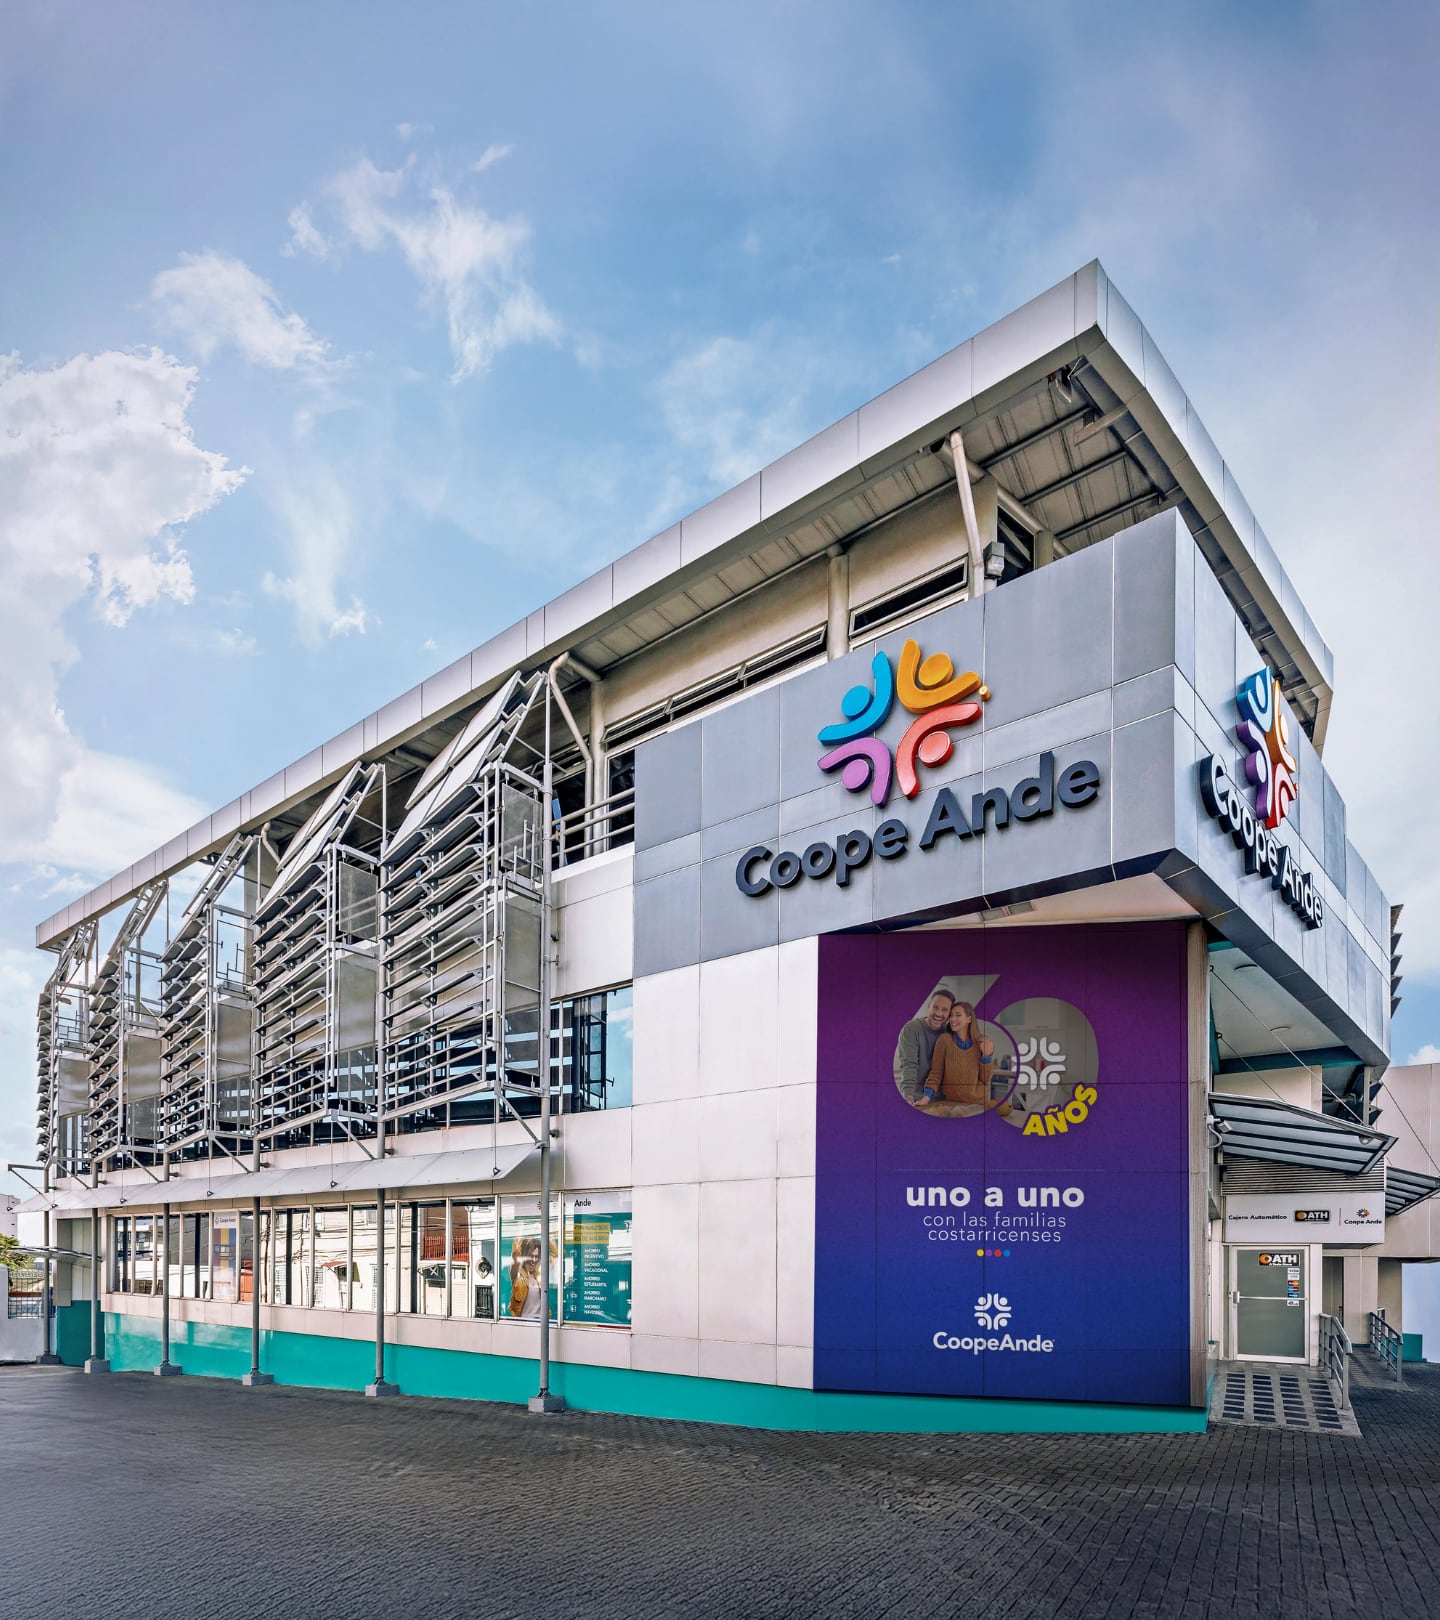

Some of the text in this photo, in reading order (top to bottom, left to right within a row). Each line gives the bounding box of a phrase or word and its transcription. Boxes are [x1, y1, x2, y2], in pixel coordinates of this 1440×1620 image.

[736, 751, 1100, 897] Coope Ande
[1201, 752, 1323, 931] Coope Ande
[1022, 1083, 1098, 1137] AÑOS
[574, 1197, 592, 1207] Ande
[906, 1186, 1085, 1208] uno a uno
[923, 1211, 1066, 1228] con las familias
[1250, 1213, 1288, 1221] Automático
[1307, 1211, 1329, 1219] ATH
[928, 1227, 1062, 1243] costarricenses
[1272, 1254, 1298, 1263] ATH
[933, 1331, 1054, 1356] CoopeAnde
